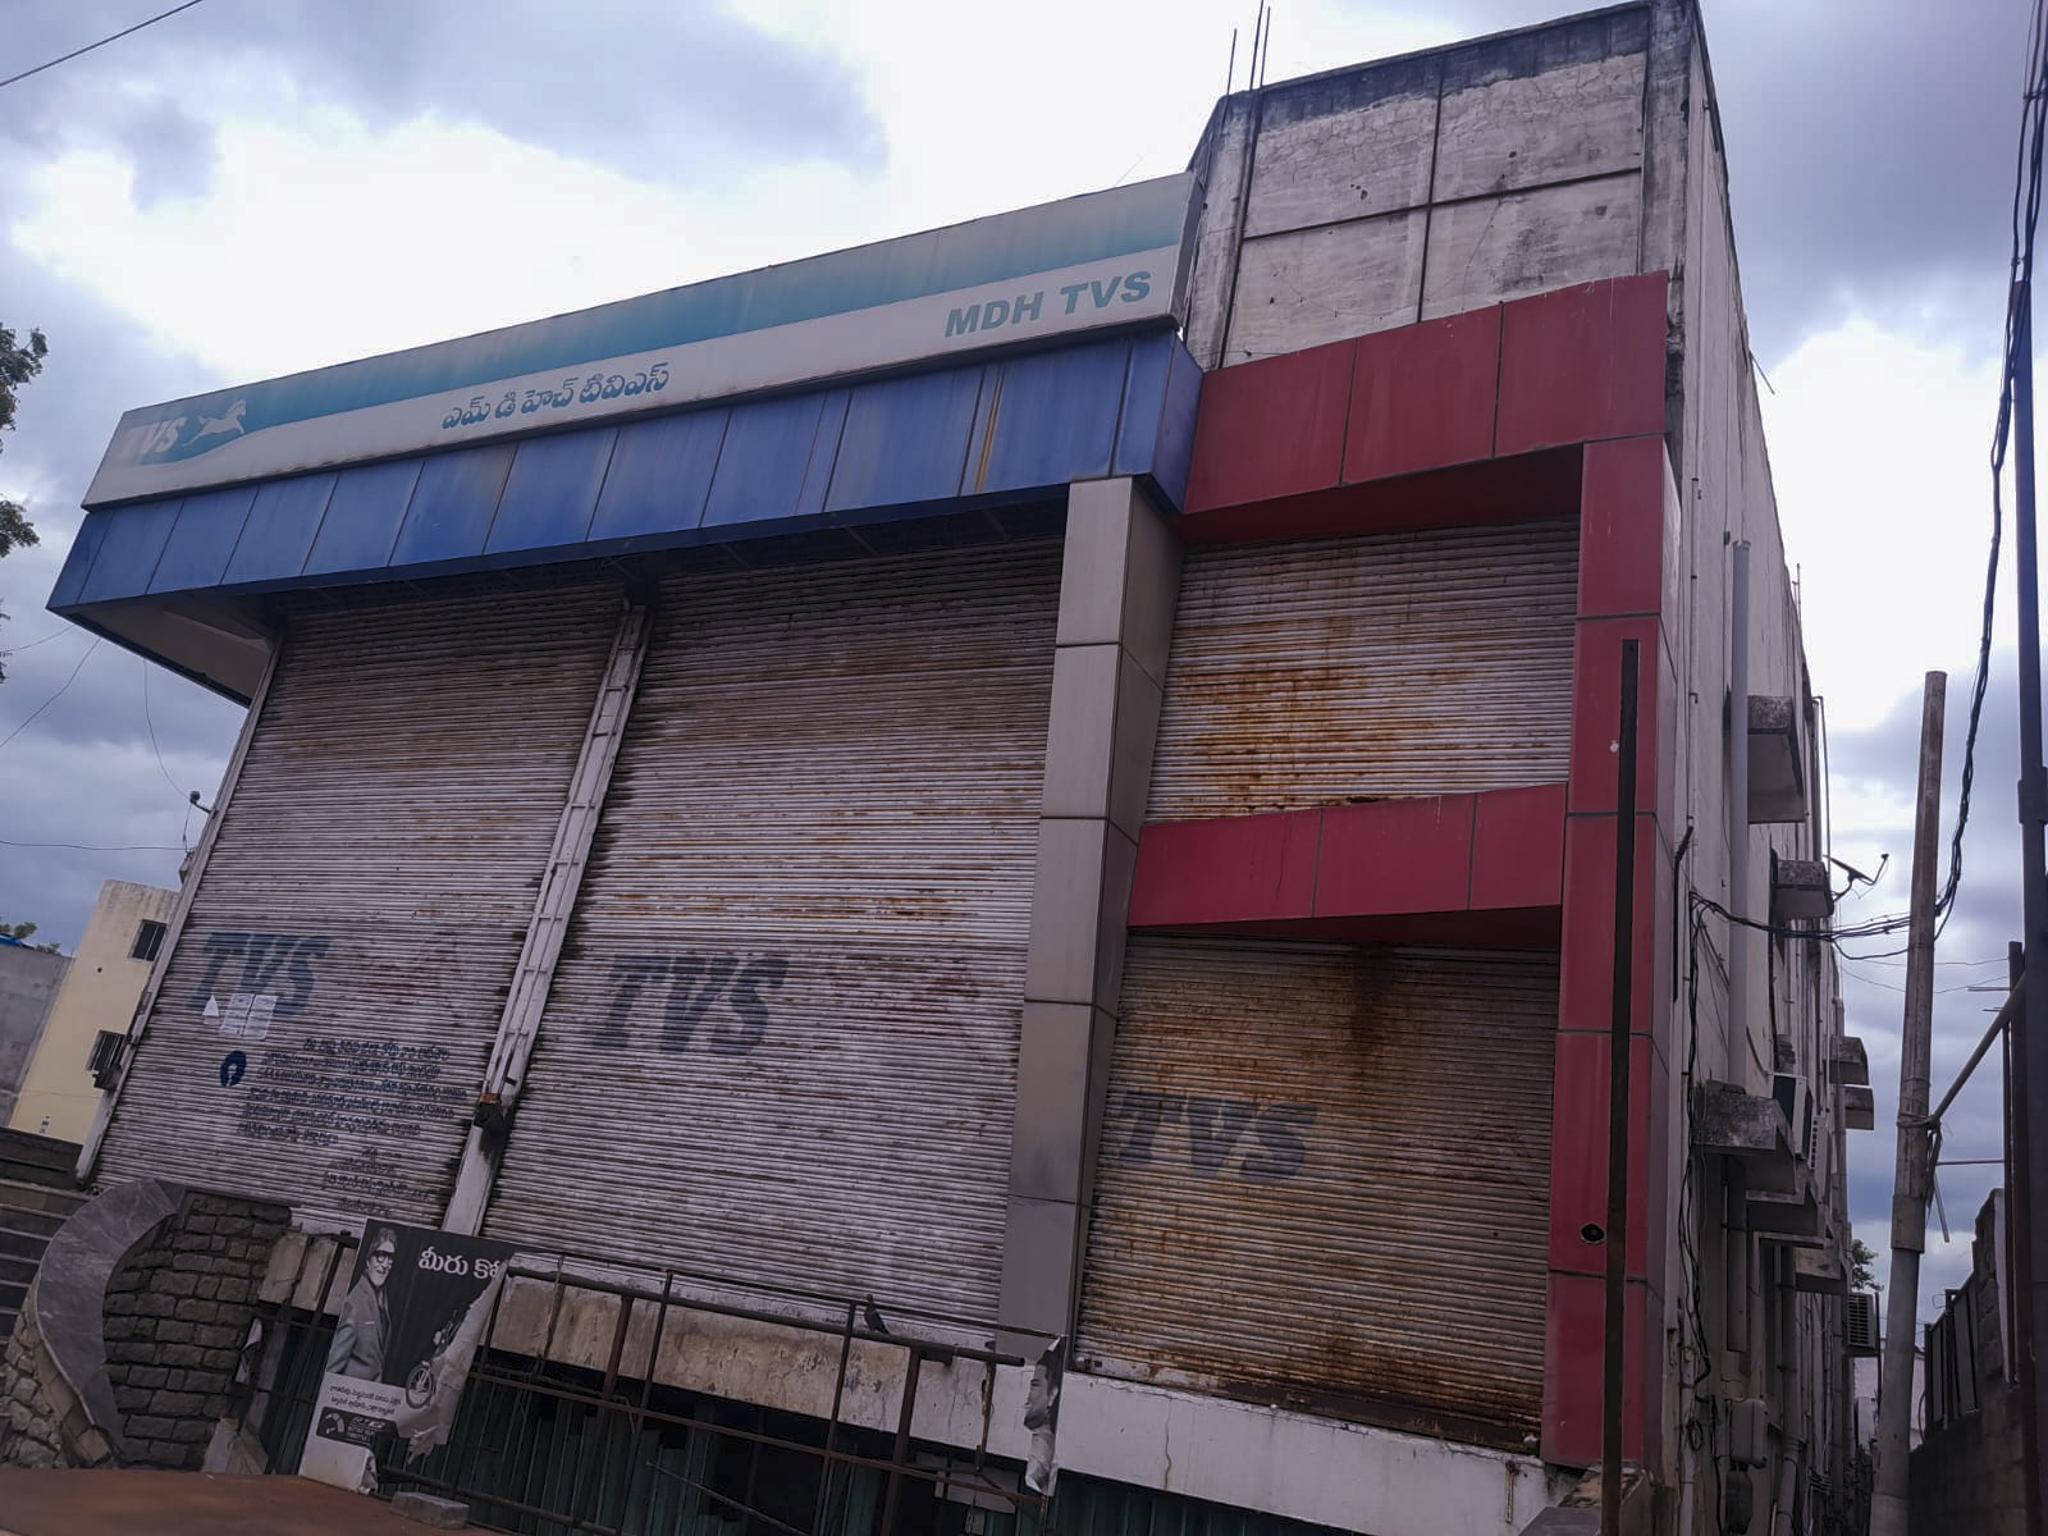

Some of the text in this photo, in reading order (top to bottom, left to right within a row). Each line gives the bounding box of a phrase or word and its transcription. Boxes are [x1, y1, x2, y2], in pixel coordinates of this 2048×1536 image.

[945, 271, 1151, 338] MDH TVS
[120, 416, 188, 458] TVS
[186, 931, 331, 1017] TVS
[592, 953, 789, 1057] TVS
[1106, 1091, 1318, 1182] TVS
[418, 1246, 468, 1275] మీరు
